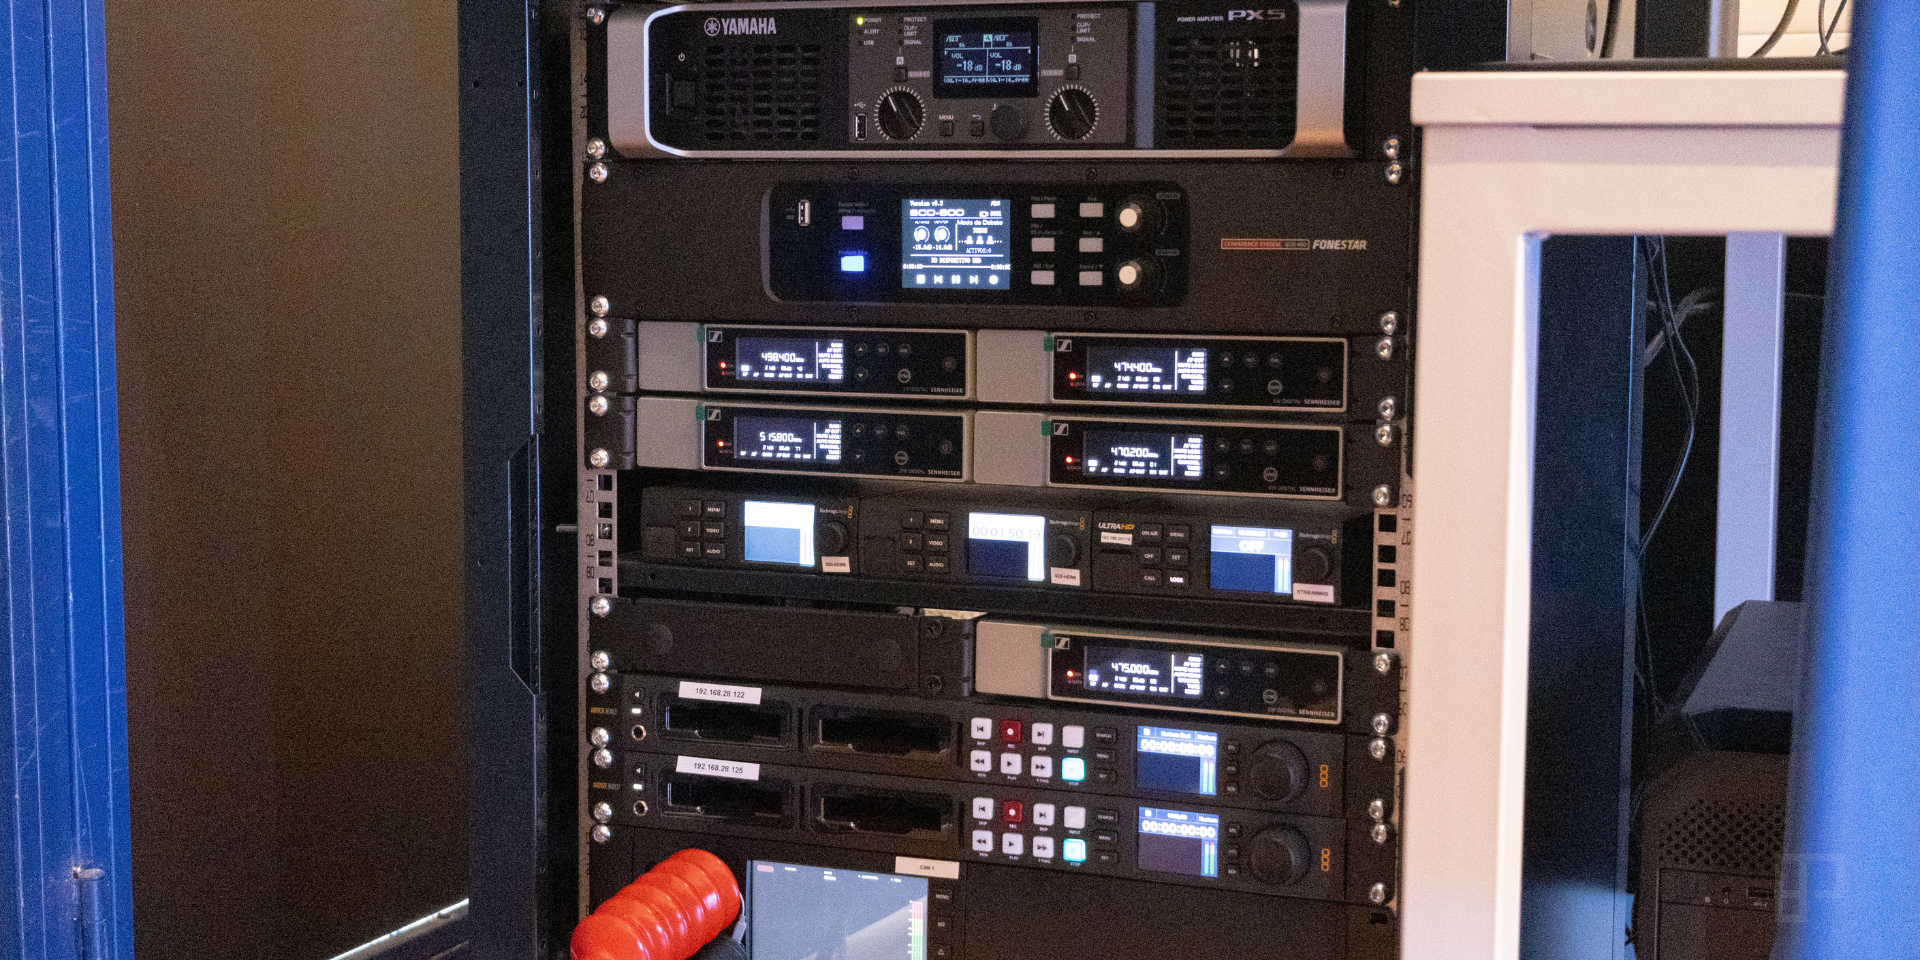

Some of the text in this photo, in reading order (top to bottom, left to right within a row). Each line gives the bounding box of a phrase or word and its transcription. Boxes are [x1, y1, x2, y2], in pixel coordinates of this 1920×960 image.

[1228, 9, 1286, 20] PX5
[721, 18, 776, 35] YAMAHA
[957, 60, 973, 71] -18
[995, 60, 1012, 71] -18
[1313, 240, 1367, 250] FONESTAR
[1098, 522, 1134, 530] ULTRAHD
[695, 687, 745, 698] 192.168.28.122
[694, 763, 744, 774] 192.168.28.125
[1142, 819, 1216, 838] 00:00:00:00
